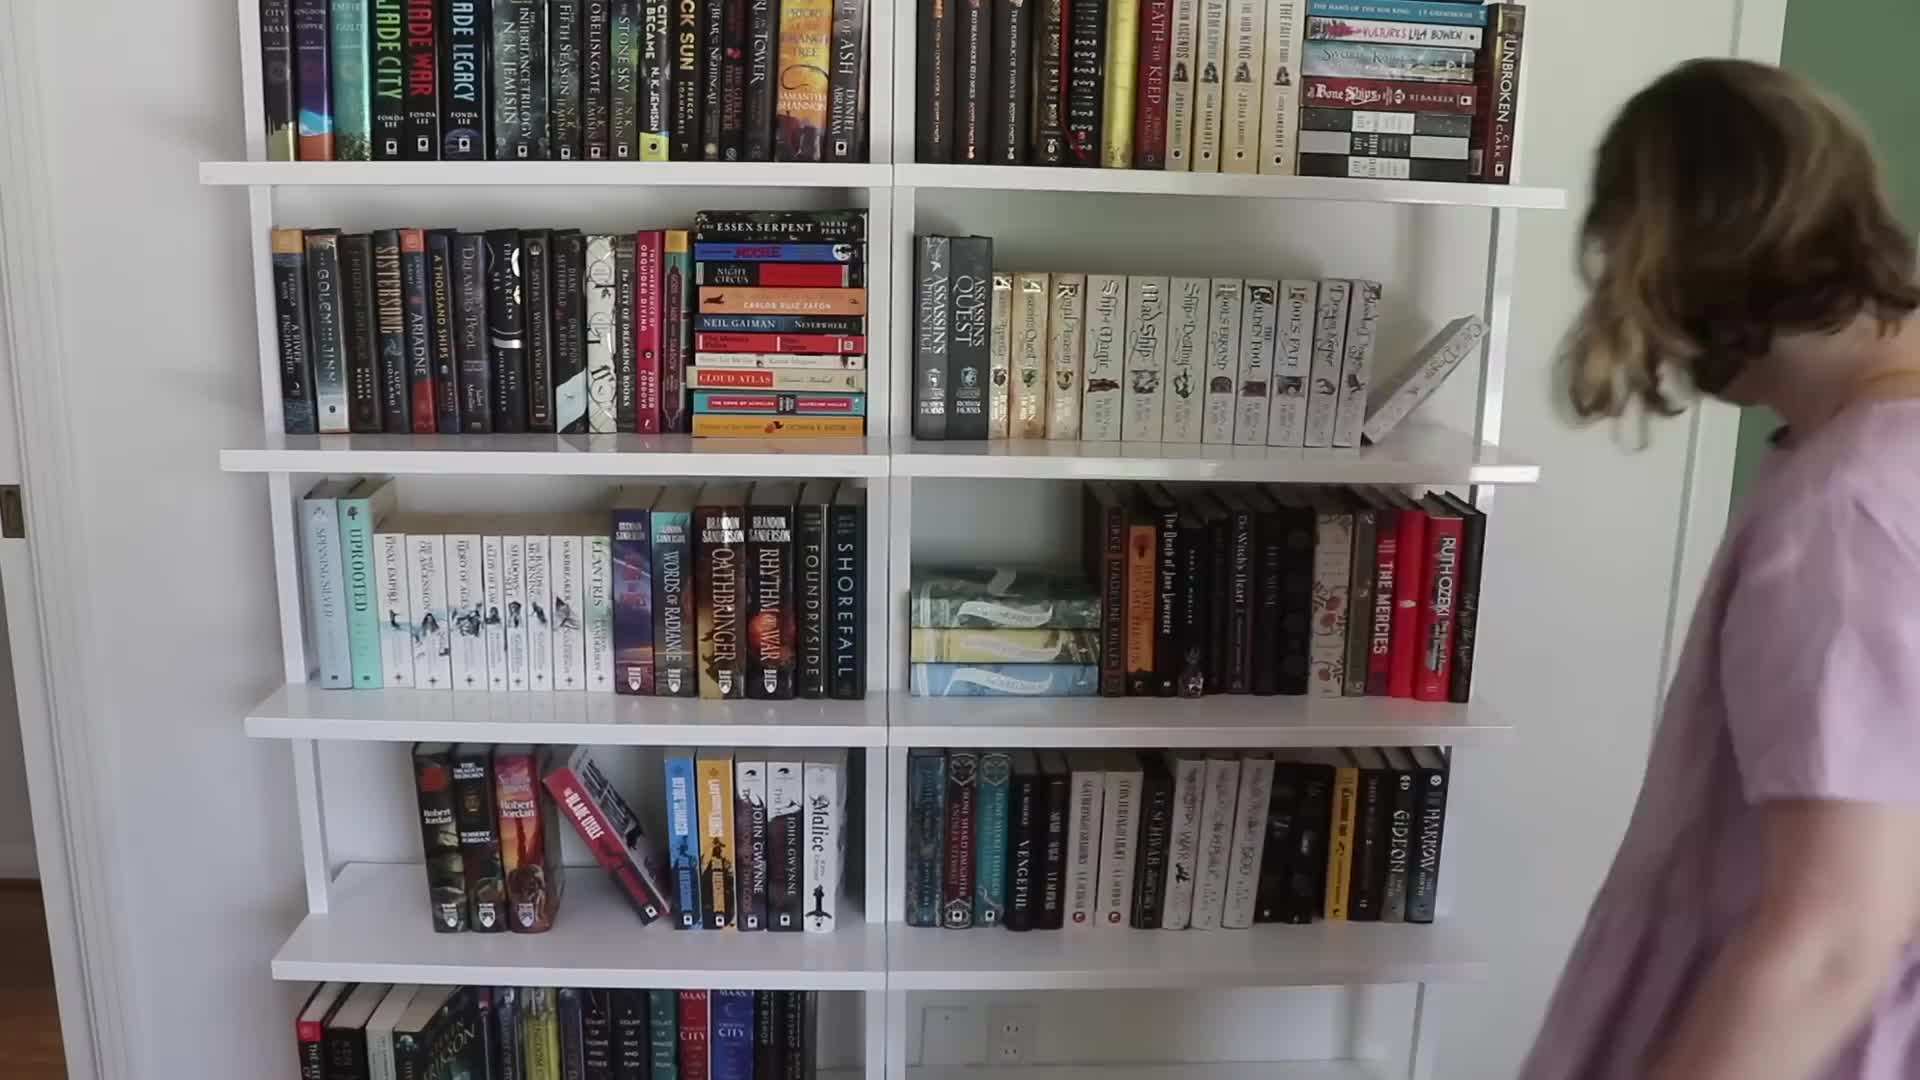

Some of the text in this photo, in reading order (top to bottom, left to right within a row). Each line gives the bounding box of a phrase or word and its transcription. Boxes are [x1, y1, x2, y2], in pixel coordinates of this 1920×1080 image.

[645, 4, 656, 60] BECAME
[656, 4, 668, 35] CITY
[710, 7, 721, 36] BEAR
[1280, 3, 1293, 20] THE
[679, 32, 695, 71] SUN
[1175, 22, 1190, 58] ASCENDS
[1239, 35, 1251, 60] KING
[1362, 25, 1464, 41] VULTURES LILA BOWEN
[409, 52, 433, 97] WAR
[453, 43, 475, 102] LEGACY
[558, 44, 572, 96] SEASON
[617, 16, 630, 93] STONE SKY
[751, 31, 769, 85] TOWER
[838, 38, 855, 74] ASH
[378, 57, 402, 99] CITY
[503, 60, 517, 124] JEMISIN
[1149, 65, 1162, 104] KEEP
[1315, 83, 1382, 105] Bone Ships
[1497, 39, 1519, 123] UNBROKEN
[410, 111, 437, 119] FONDA
[451, 111, 479, 119] FONDA
[650, 89, 660, 132] JEMISIN
[831, 86, 843, 136] ABRAHAM
[844, 88, 856, 132] DANIEL
[1493, 124, 1504, 158] CLARK
[716, 222, 814, 233] ESSEX SERPENT
[317, 268, 333, 325] GOLEM
[375, 245, 404, 334] SISTERSONG
[434, 264, 447, 326] THOUSAND
[568, 267, 577, 293] DIANE
[621, 283, 630, 305] CITY
[640, 244, 648, 332] ORQUIDEA DIVINA
[1181, 282, 1201, 313] Ship
[622, 307, 630, 320] OF
[703, 318, 729, 327] NEIL
[731, 319, 776, 328] GAIMAN
[920, 277, 934, 352] APPRENTICE
[952, 275, 974, 347] QUEST
[1092, 280, 1119, 369] Ship Magic
[1134, 283, 1164, 359] Mad Ship
[1249, 286, 1275, 368] GOLDEN FOOL
[293, 333, 302, 364] RIVER
[410, 312, 427, 376] ARIADNE
[438, 328, 449, 359] SHIPS
[622, 322, 631, 373] DREAMING
[1217, 326, 1230, 370] ERRAND
[1264, 326, 1273, 341] THE
[1287, 337, 1301, 368] FATE
[386, 360, 396, 406] HOLLAND
[623, 374, 631, 407] BOOKS
[699, 374, 735, 382] CLOUD
[737, 375, 771, 384] ATLAS
[702, 529, 745, 544] SANDERSON
[705, 516, 740, 530] BRANDON
[749, 529, 791, 542] SANDERSON
[752, 516, 787, 529] BRANDON
[1164, 512, 1179, 530] The
[1163, 531, 1178, 559] Death
[1439, 536, 1457, 576] RUTH
[349, 527, 368, 612] UPROOTED
[510, 543, 520, 590] SHADOWS
[562, 540, 572, 602] WARBREAKER
[591, 540, 605, 607] ELANTRIS
[663, 550, 680, 593] WORDS
[1162, 570, 1177, 590] Jane
[321, 580, 333, 618] SILVER
[711, 548, 737, 663] OATHBRINGER
[759, 549, 781, 662] RHYTHM WAR
[1235, 573, 1249, 604] Heart
[1373, 562, 1395, 656] THE MERCIES
[1435, 577, 1454, 616] OZEKI
[805, 544, 820, 676] FOUNDRYSIDE
[837, 543, 854, 677] SHOREFALL
[1161, 592, 1177, 635] Lawrence
[664, 606, 683, 662] RADIANCE
[424, 808, 451, 817] Robert
[425, 816, 452, 825] Jordan
[501, 799, 534, 809] Robert
[502, 809, 535, 818] Jordan
[564, 791, 590, 821] BLADE
[809, 794, 830, 853] Malice
[751, 806, 764, 895] JOHN GWYNNE
[787, 816, 797, 896] JOHN GWYNNE
[1390, 809, 1411, 873] GIDEON
[1418, 808, 1442, 872] HARROW
[1015, 840, 1031, 910] VENGEFUL
[680, 1031, 705, 1042] CITY
[718, 1027, 744, 1038] CITY
